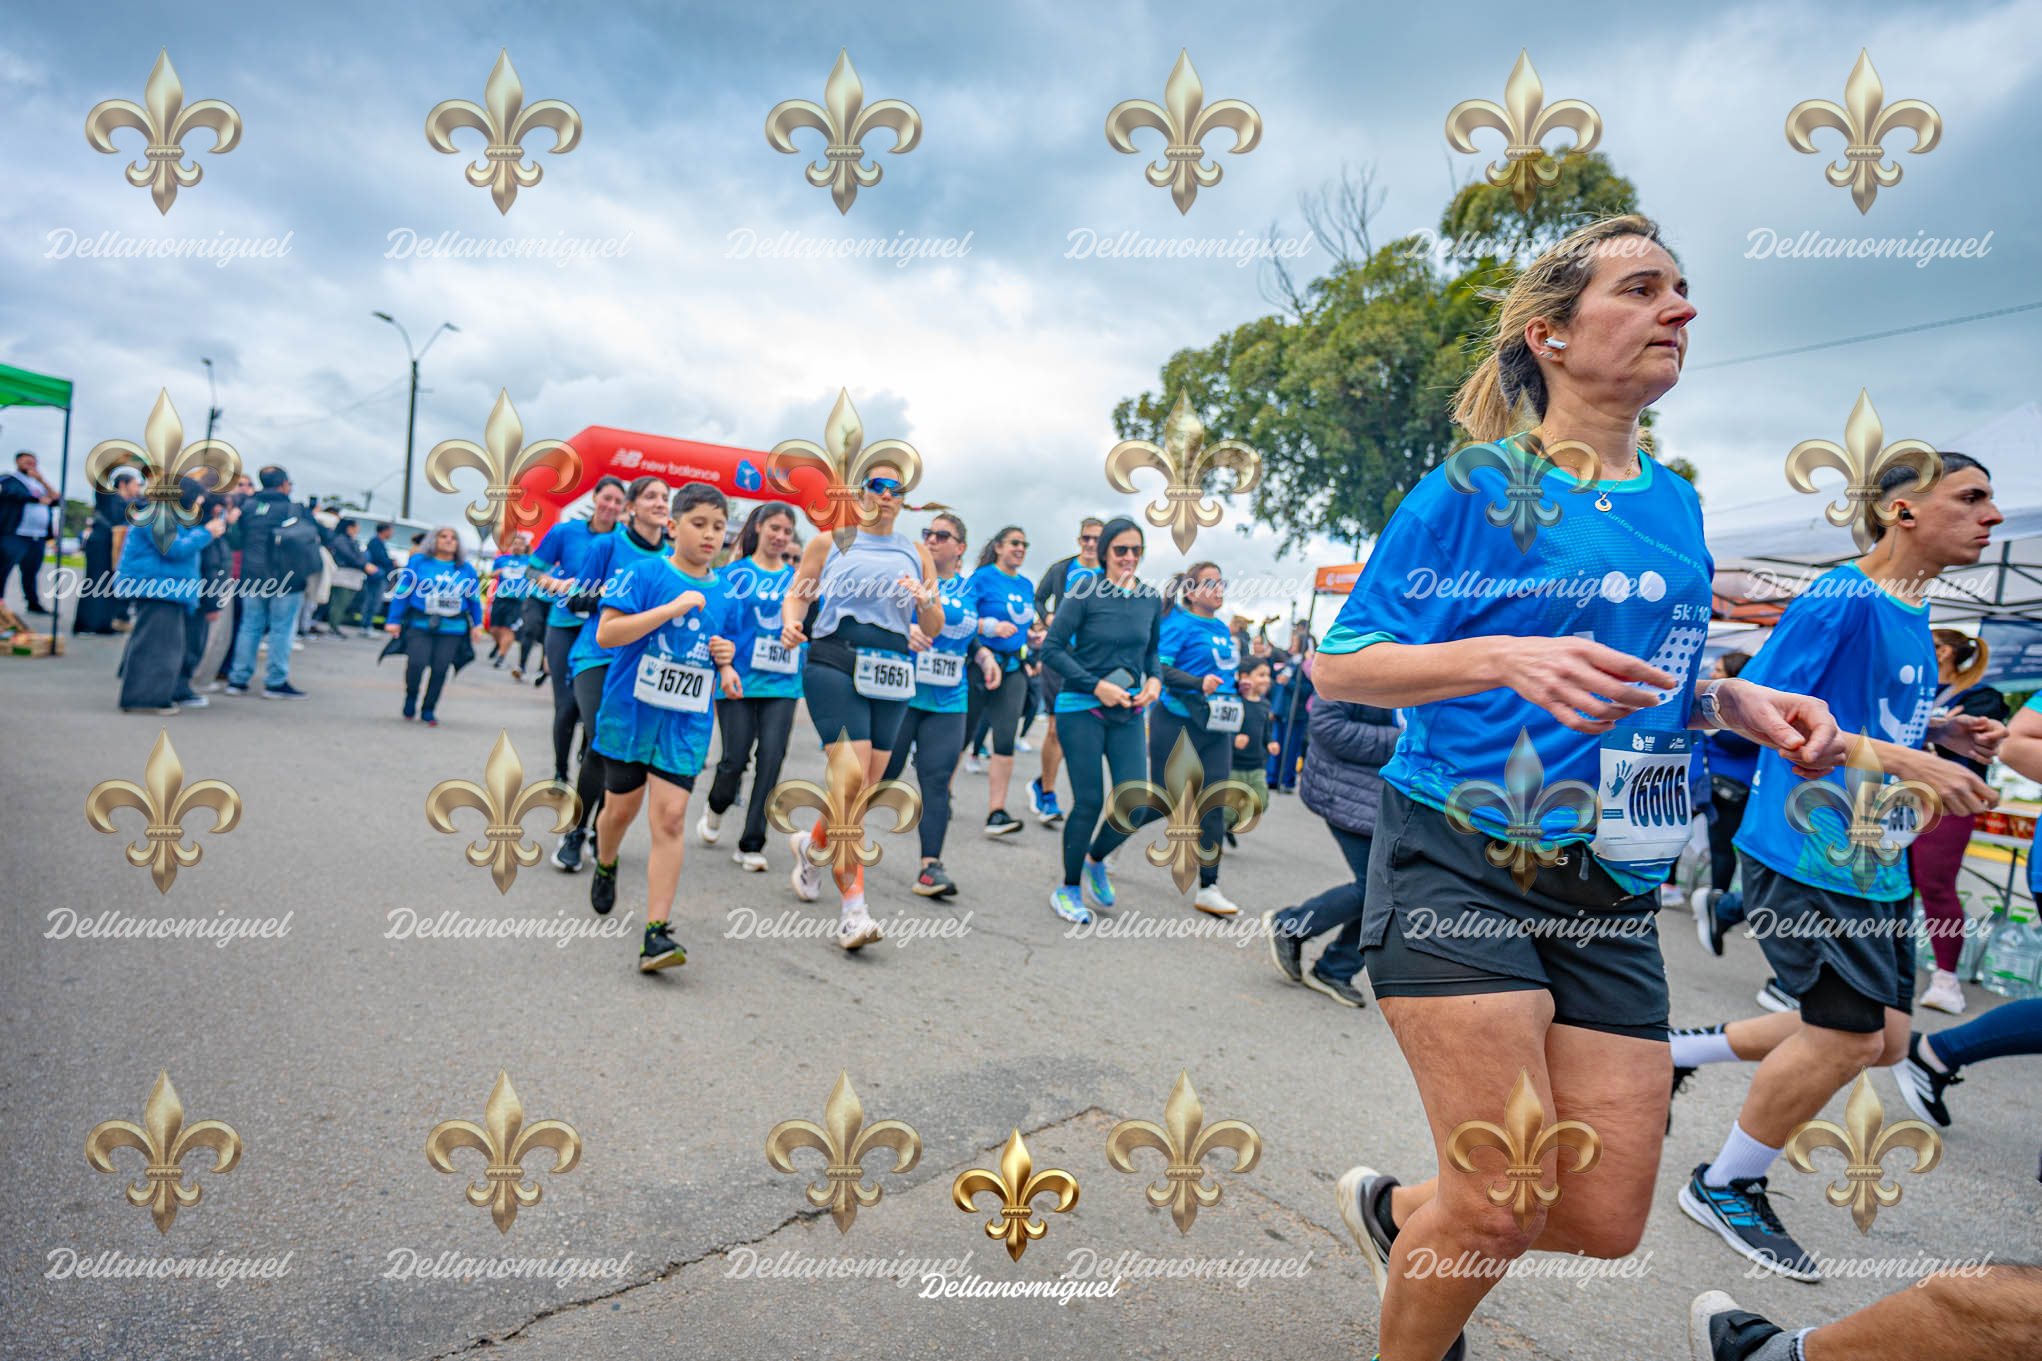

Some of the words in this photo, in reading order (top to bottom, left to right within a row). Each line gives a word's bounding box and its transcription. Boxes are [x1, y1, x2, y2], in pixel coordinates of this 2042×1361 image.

[657, 668, 704, 698] 15720
[873, 663, 910, 688] 15651
[1628, 765, 1688, 827] 16606
